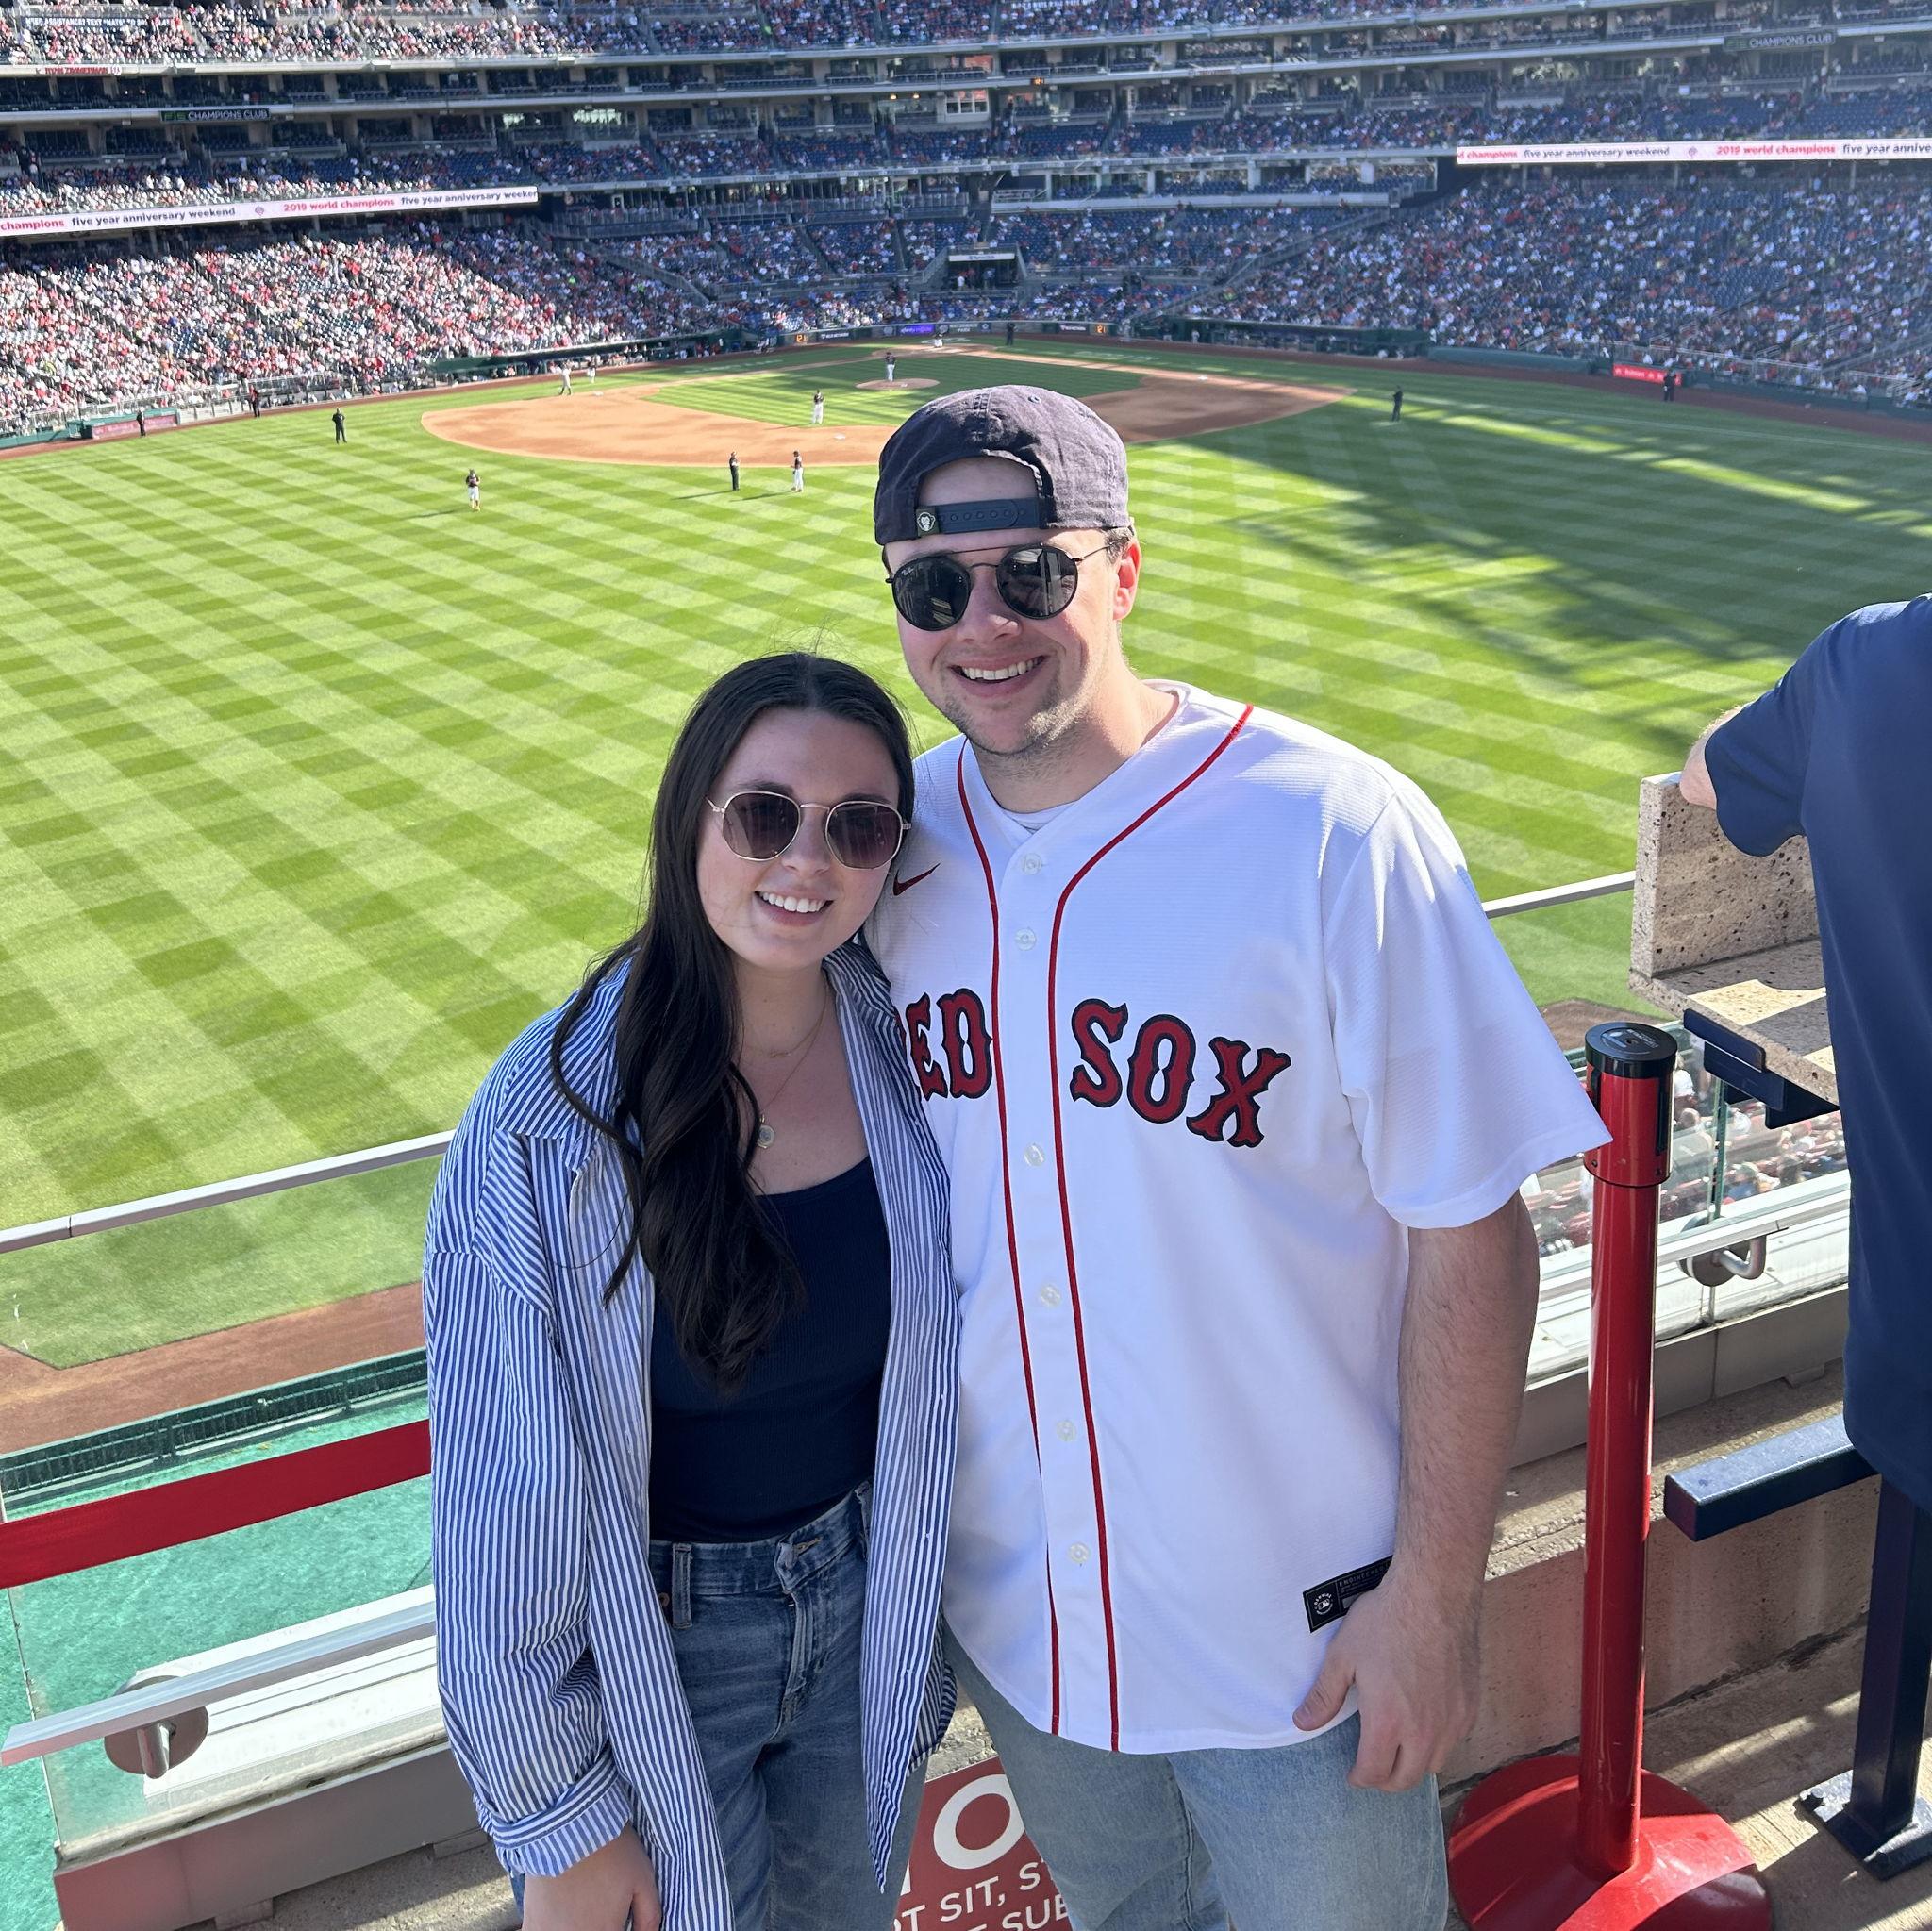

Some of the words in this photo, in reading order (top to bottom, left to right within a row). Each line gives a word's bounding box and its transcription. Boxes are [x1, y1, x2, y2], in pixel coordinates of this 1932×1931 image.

[1750, 35, 1804, 48] CHAMPIONS
[1807, 32, 1832, 44] CLUB
[188, 110, 242, 122] CHAMPIONS
[244, 109, 268, 120] CLUB
[1467, 150, 1518, 159] champions
[1524, 148, 1541, 158] five
[1542, 150, 1563, 159] year
[1565, 148, 1624, 159] anniversary
[1625, 147, 1671, 157] weekend
[1716, 146, 1740, 156] 2019
[1744, 144, 1774, 155] world
[1775, 144, 1837, 157] champions
[1842, 143, 1863, 154] five
[1865, 145, 1890, 156] year
[939, 175, 960, 185] PNC
[0, 218, 65, 231] champions
[72, 216, 93, 226] five
[95, 216, 120, 227] year
[123, 209, 186, 224] anniversary
[189, 208, 236, 219] weekend
[283, 202, 308, 212] 2019
[309, 200, 338, 210] world
[341, 196, 395, 210] champions
[401, 196, 421, 206] five
[422, 195, 442, 205] year
[445, 191, 501, 204] anniversary
[898, 988, 994, 1102] ED
[1069, 998, 1292, 1149] SOX
[940, 1875, 1007, 1923] SIT,
[1019, 1856, 1045, 1891] S
